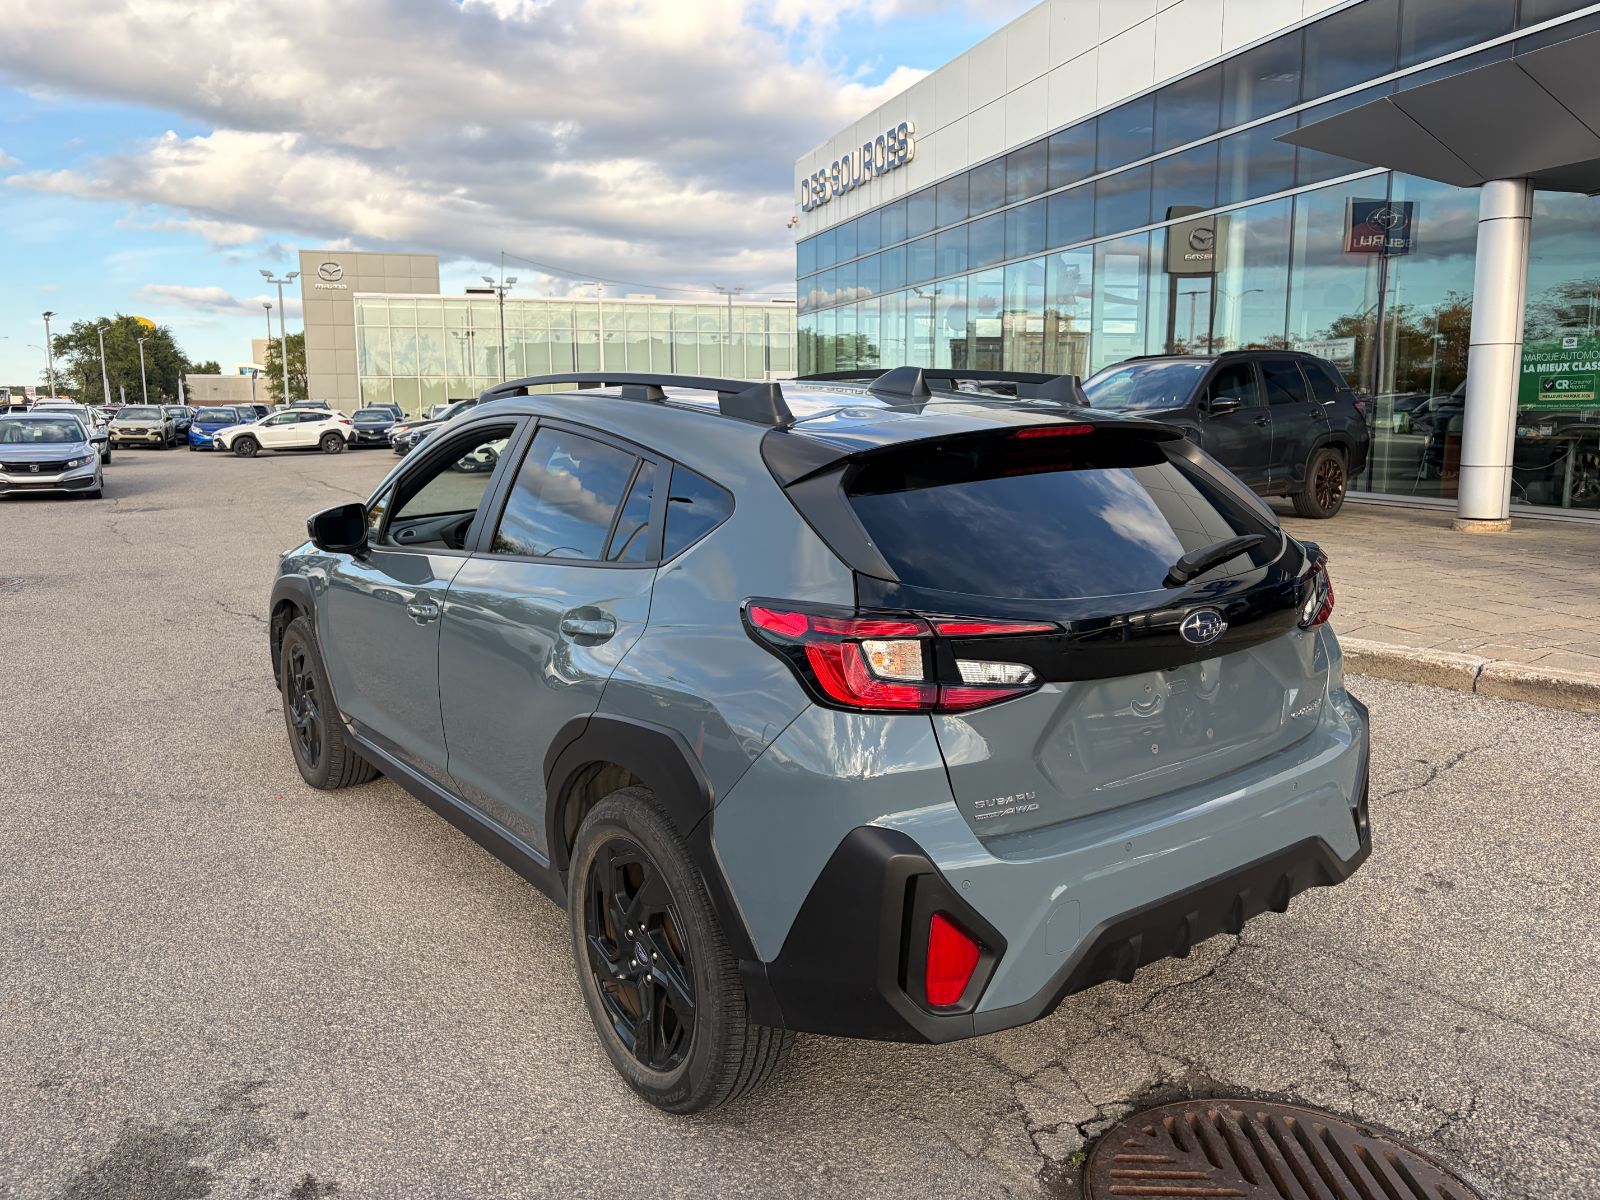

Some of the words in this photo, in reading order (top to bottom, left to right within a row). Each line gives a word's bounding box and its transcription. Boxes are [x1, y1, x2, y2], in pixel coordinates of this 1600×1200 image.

[801, 168, 832, 212] DES
[831, 121, 915, 196] SOURCES
[1523, 352, 1559, 362] MARQUE
[1560, 350, 1600, 360] AUTOMO
[1523, 364, 1535, 373] LA
[1536, 362, 1570, 373] MIEUX
[1555, 379, 1570, 390] CR
[974, 791, 1036, 809] SUBARU
[1001, 803, 1040, 817] AWD
